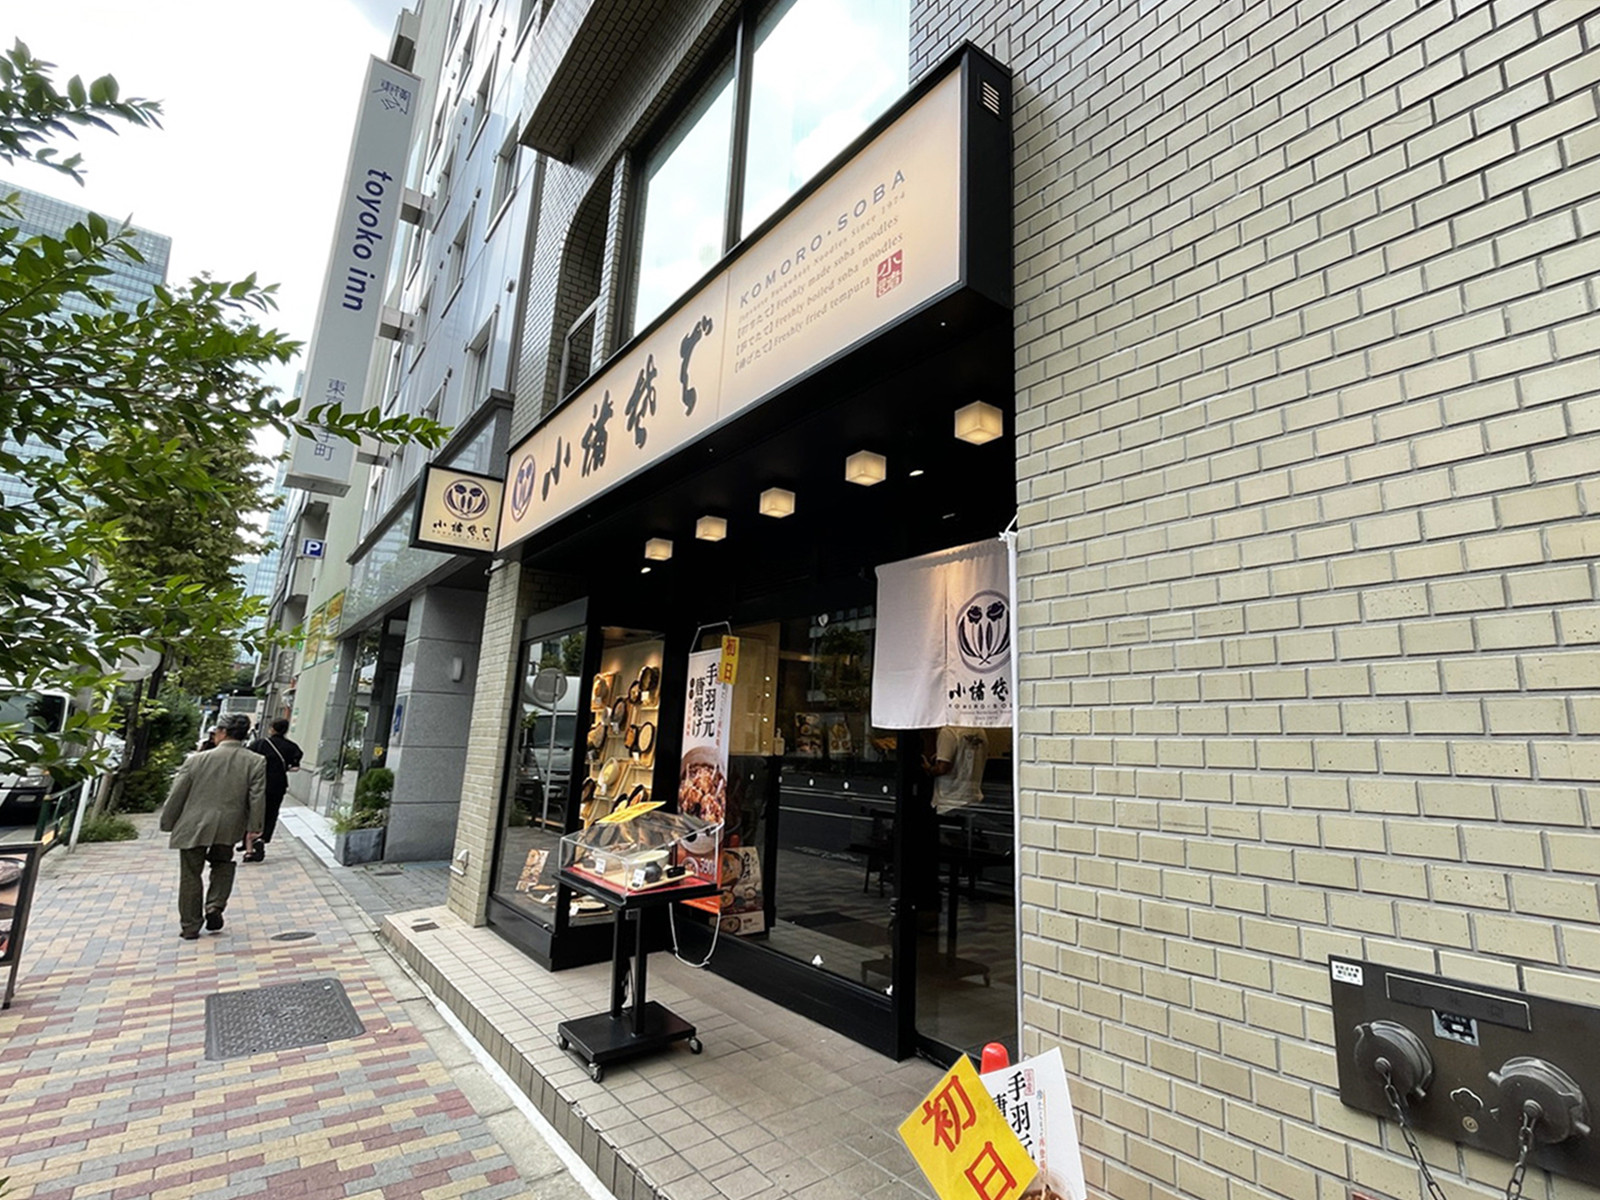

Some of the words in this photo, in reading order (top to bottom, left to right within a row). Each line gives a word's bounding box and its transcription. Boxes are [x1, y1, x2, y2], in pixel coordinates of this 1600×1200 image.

[352, 168, 393, 260] toyoko
[808, 265, 832, 287] made
[834, 247, 856, 269] soba
[858, 214, 899, 251] noodles
[837, 263, 859, 286] soba
[862, 233, 904, 268] noodles
[342, 267, 375, 312] inn
[805, 303, 828, 326] fried
[830, 276, 871, 309] tempura
[307, 541, 321, 555] P
[703, 662, 718, 738] 手羽元
[921, 1074, 1018, 1200] 初日
